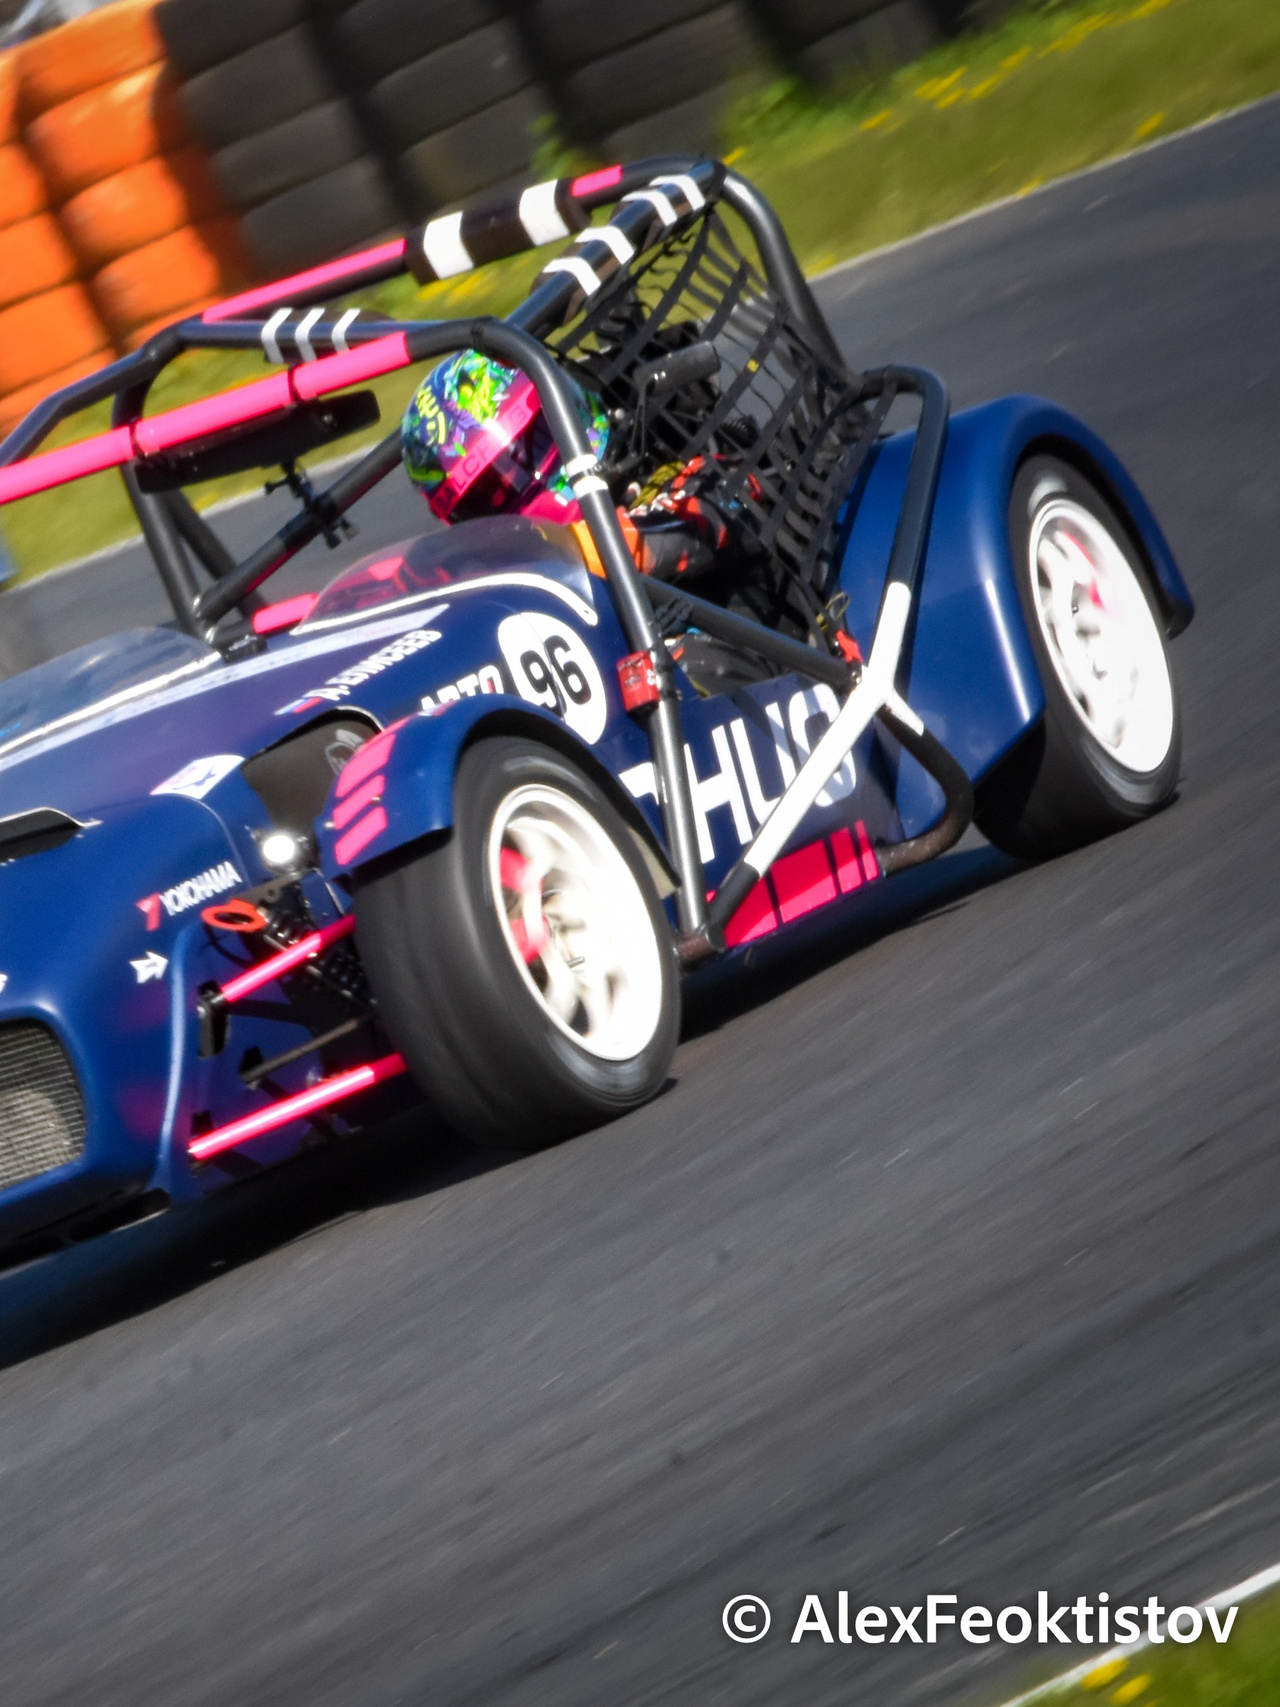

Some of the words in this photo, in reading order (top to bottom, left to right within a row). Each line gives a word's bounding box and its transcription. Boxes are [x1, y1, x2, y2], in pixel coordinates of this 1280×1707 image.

[432, 402, 532, 515] BALCHG
[519, 634, 593, 719] 96
[619, 683, 857, 865] HUG
[159, 860, 243, 917] YOKOHAMA
